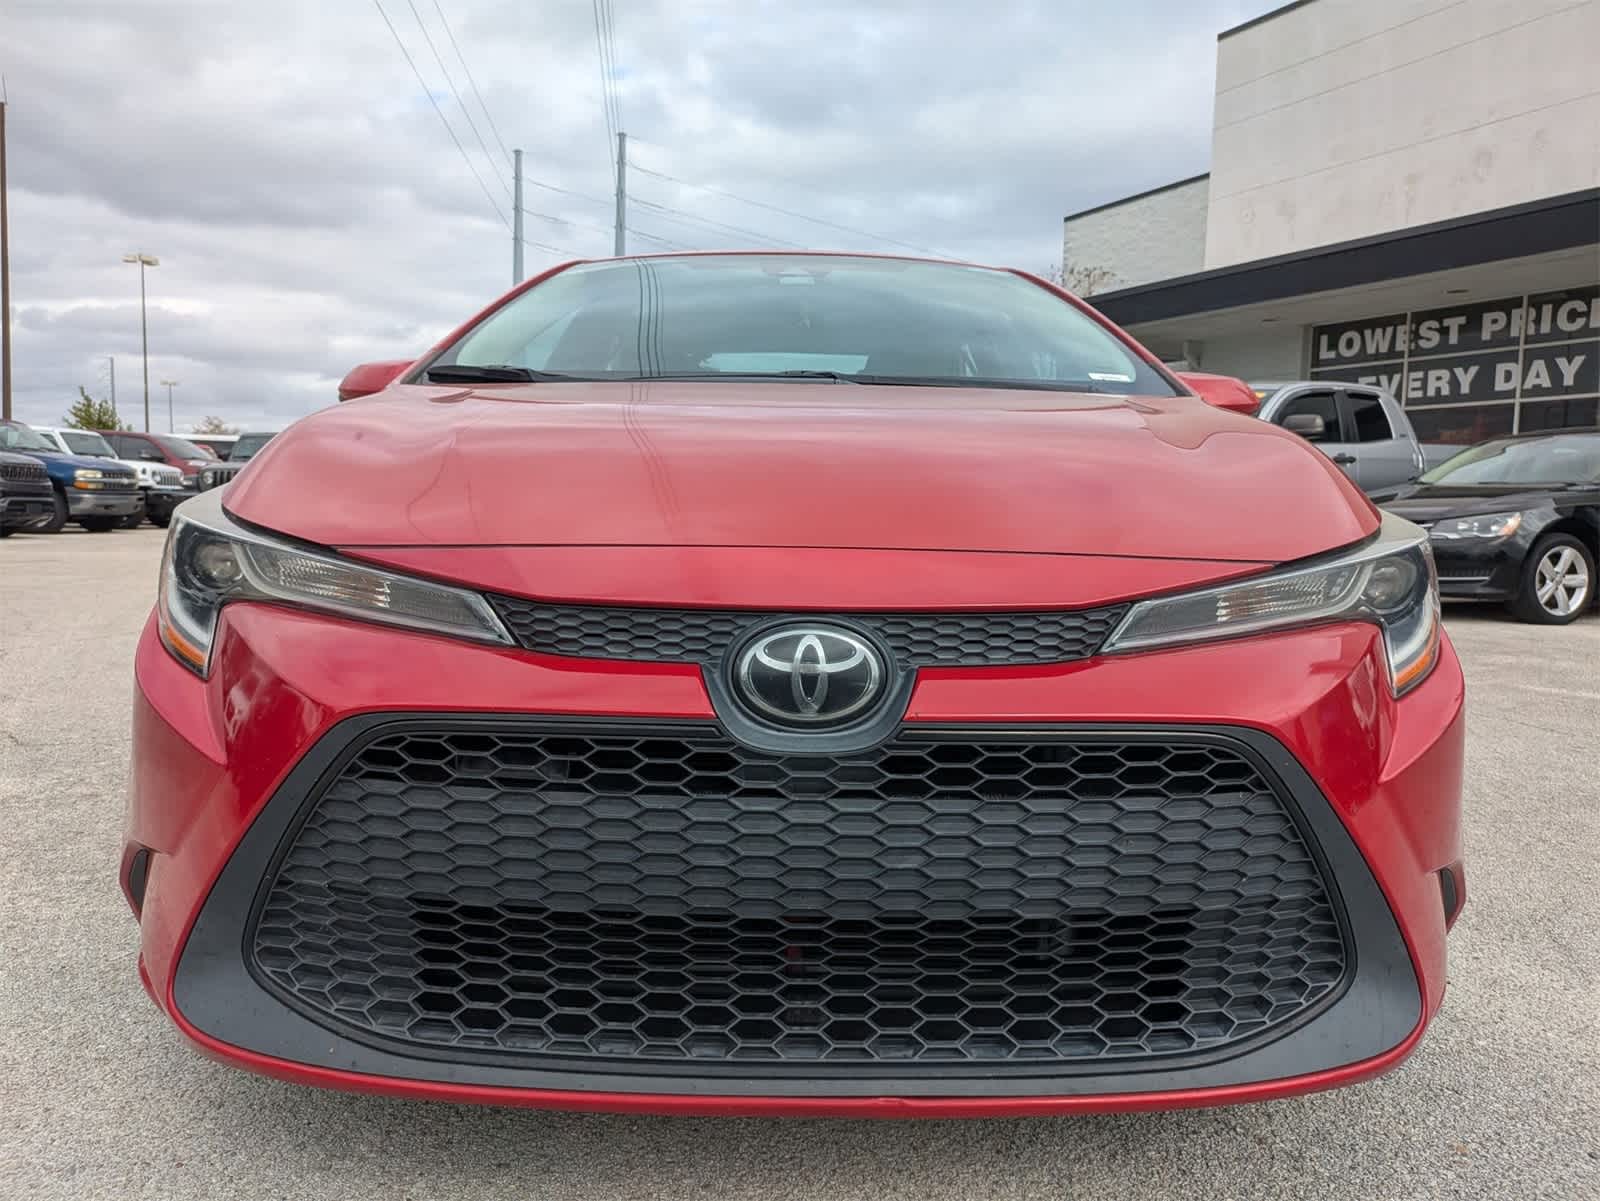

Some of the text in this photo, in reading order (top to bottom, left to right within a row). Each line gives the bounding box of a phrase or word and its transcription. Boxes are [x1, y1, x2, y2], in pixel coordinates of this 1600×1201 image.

[1319, 316, 1467, 360] LOWEST
[1358, 355, 1586, 398] VERY DAY
